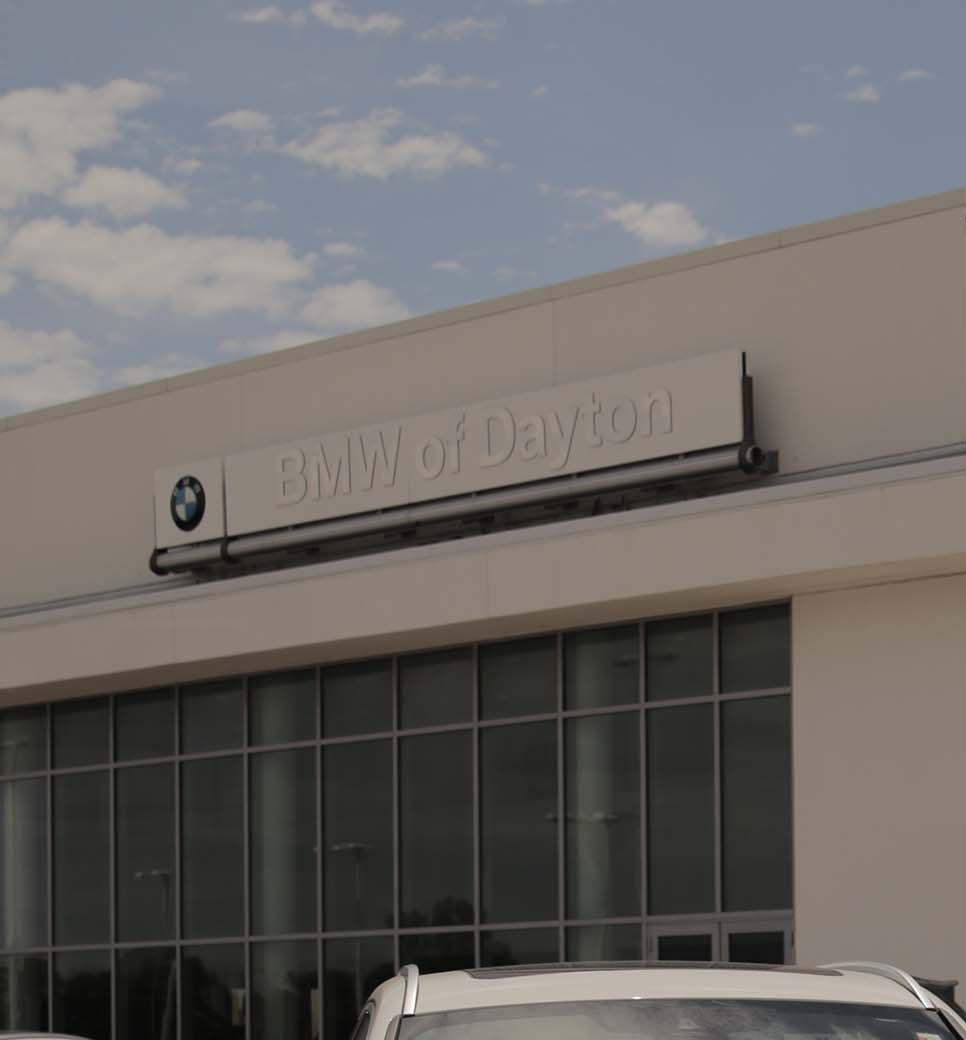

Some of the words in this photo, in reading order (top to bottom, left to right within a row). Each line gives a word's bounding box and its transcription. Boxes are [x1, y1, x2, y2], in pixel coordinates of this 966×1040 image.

[277, 424, 403, 507] BMW
[415, 411, 466, 480] of
[480, 385, 675, 470] Dayton
